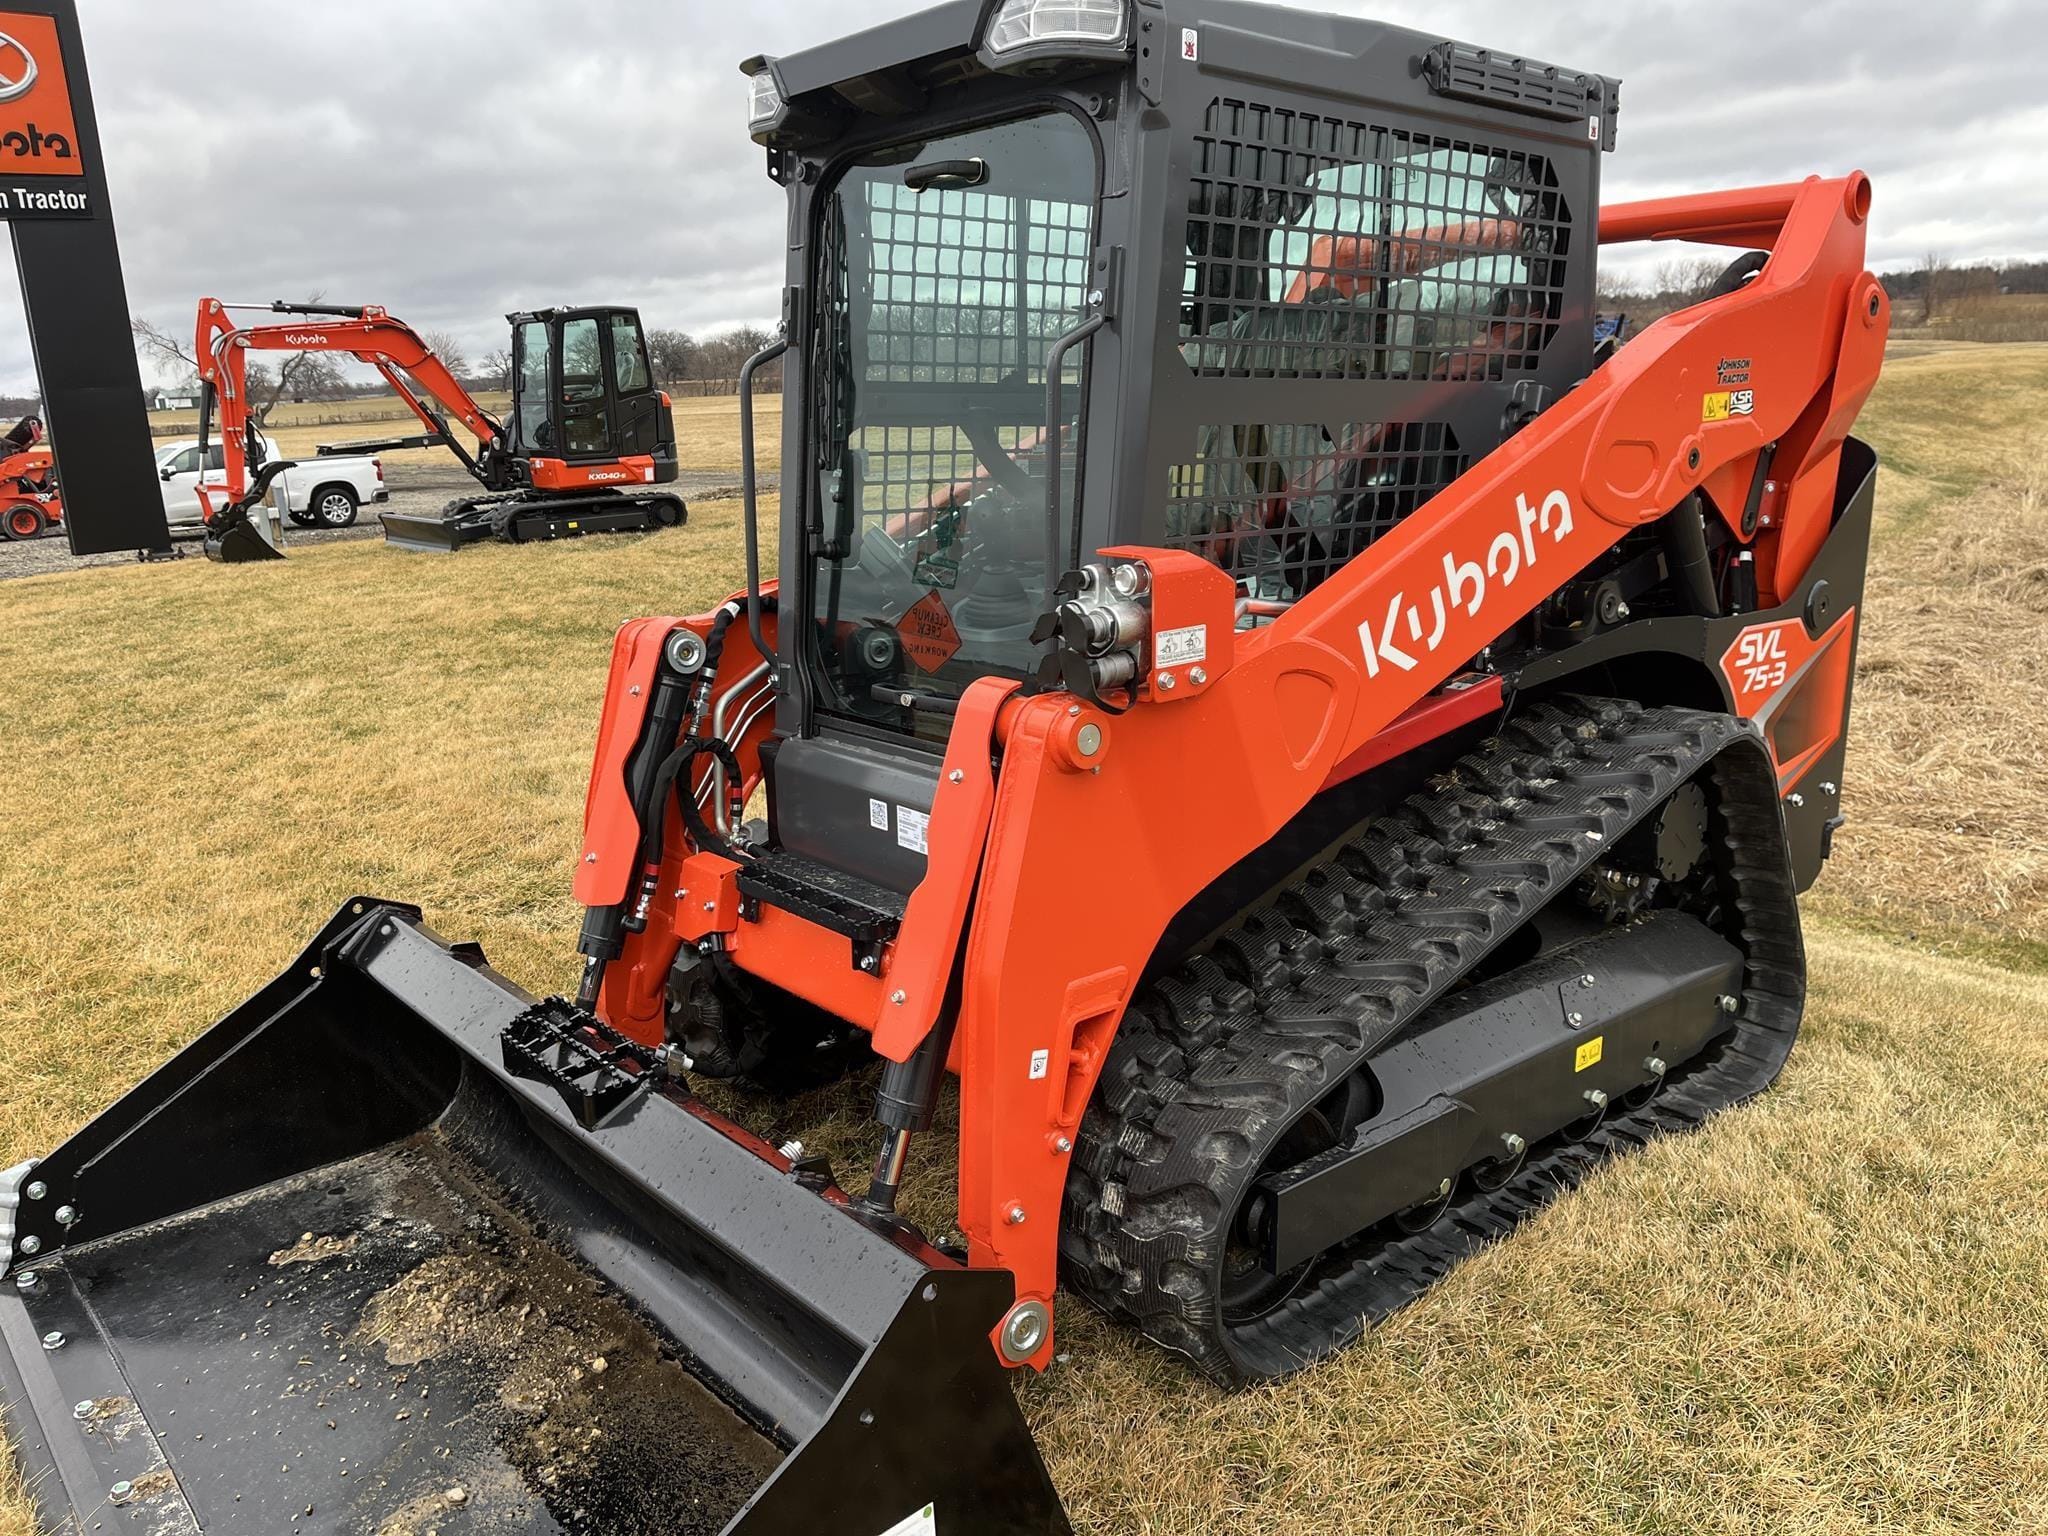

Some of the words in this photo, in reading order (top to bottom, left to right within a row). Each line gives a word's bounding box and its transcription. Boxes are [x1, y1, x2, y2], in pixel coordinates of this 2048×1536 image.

[0, 123, 71, 157] ota
[12, 188, 87, 209] Tractor
[285, 334, 328, 345] Kubota
[1717, 358, 1750, 370] JOHNSON
[1717, 372, 1749, 384] TRACTOR
[1730, 390, 1753, 405] KSR
[1357, 489, 1574, 679] Kubota
[1735, 628, 1787, 667] SVL
[1742, 661, 1787, 694] 75-3
